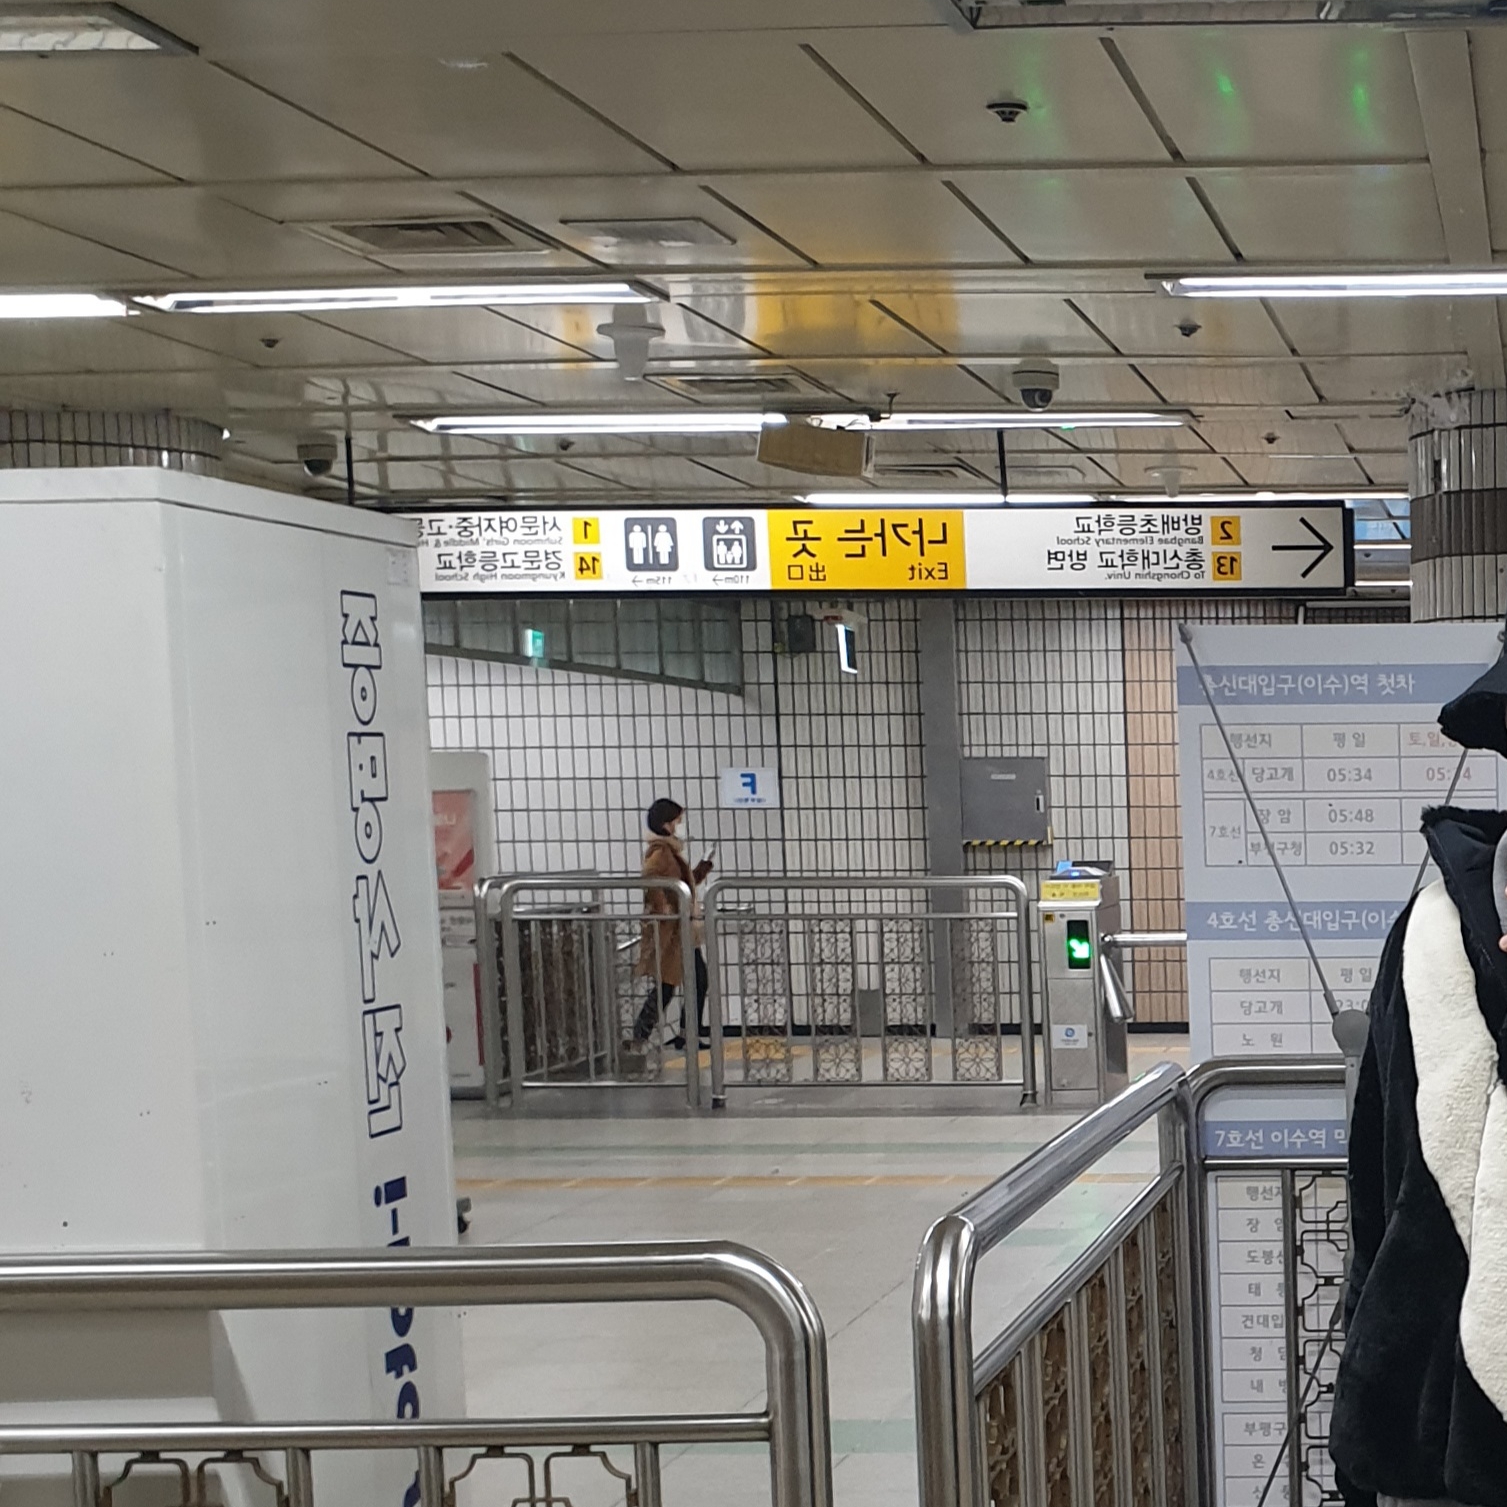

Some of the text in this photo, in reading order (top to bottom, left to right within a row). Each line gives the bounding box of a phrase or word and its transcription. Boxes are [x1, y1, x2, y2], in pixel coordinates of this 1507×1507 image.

[1377, 673, 1416, 695] 첫차
[1251, 766, 1294, 784] 당고개
[1326, 767, 1373, 783] 05:34
[1426, 766, 1472, 782] 05:4
[1209, 824, 1242, 839] 7호선
[1328, 808, 1374, 824] 05:48
[1329, 841, 1375, 856] 05:32
[1206, 912, 1257, 930] 4호선
[1239, 968, 1281, 983] 행선지
[1240, 1000, 1283, 1016] 당고개
[1215, 1131, 1264, 1148] 7호선
[1271, 1129, 1327, 1148] 이수역
